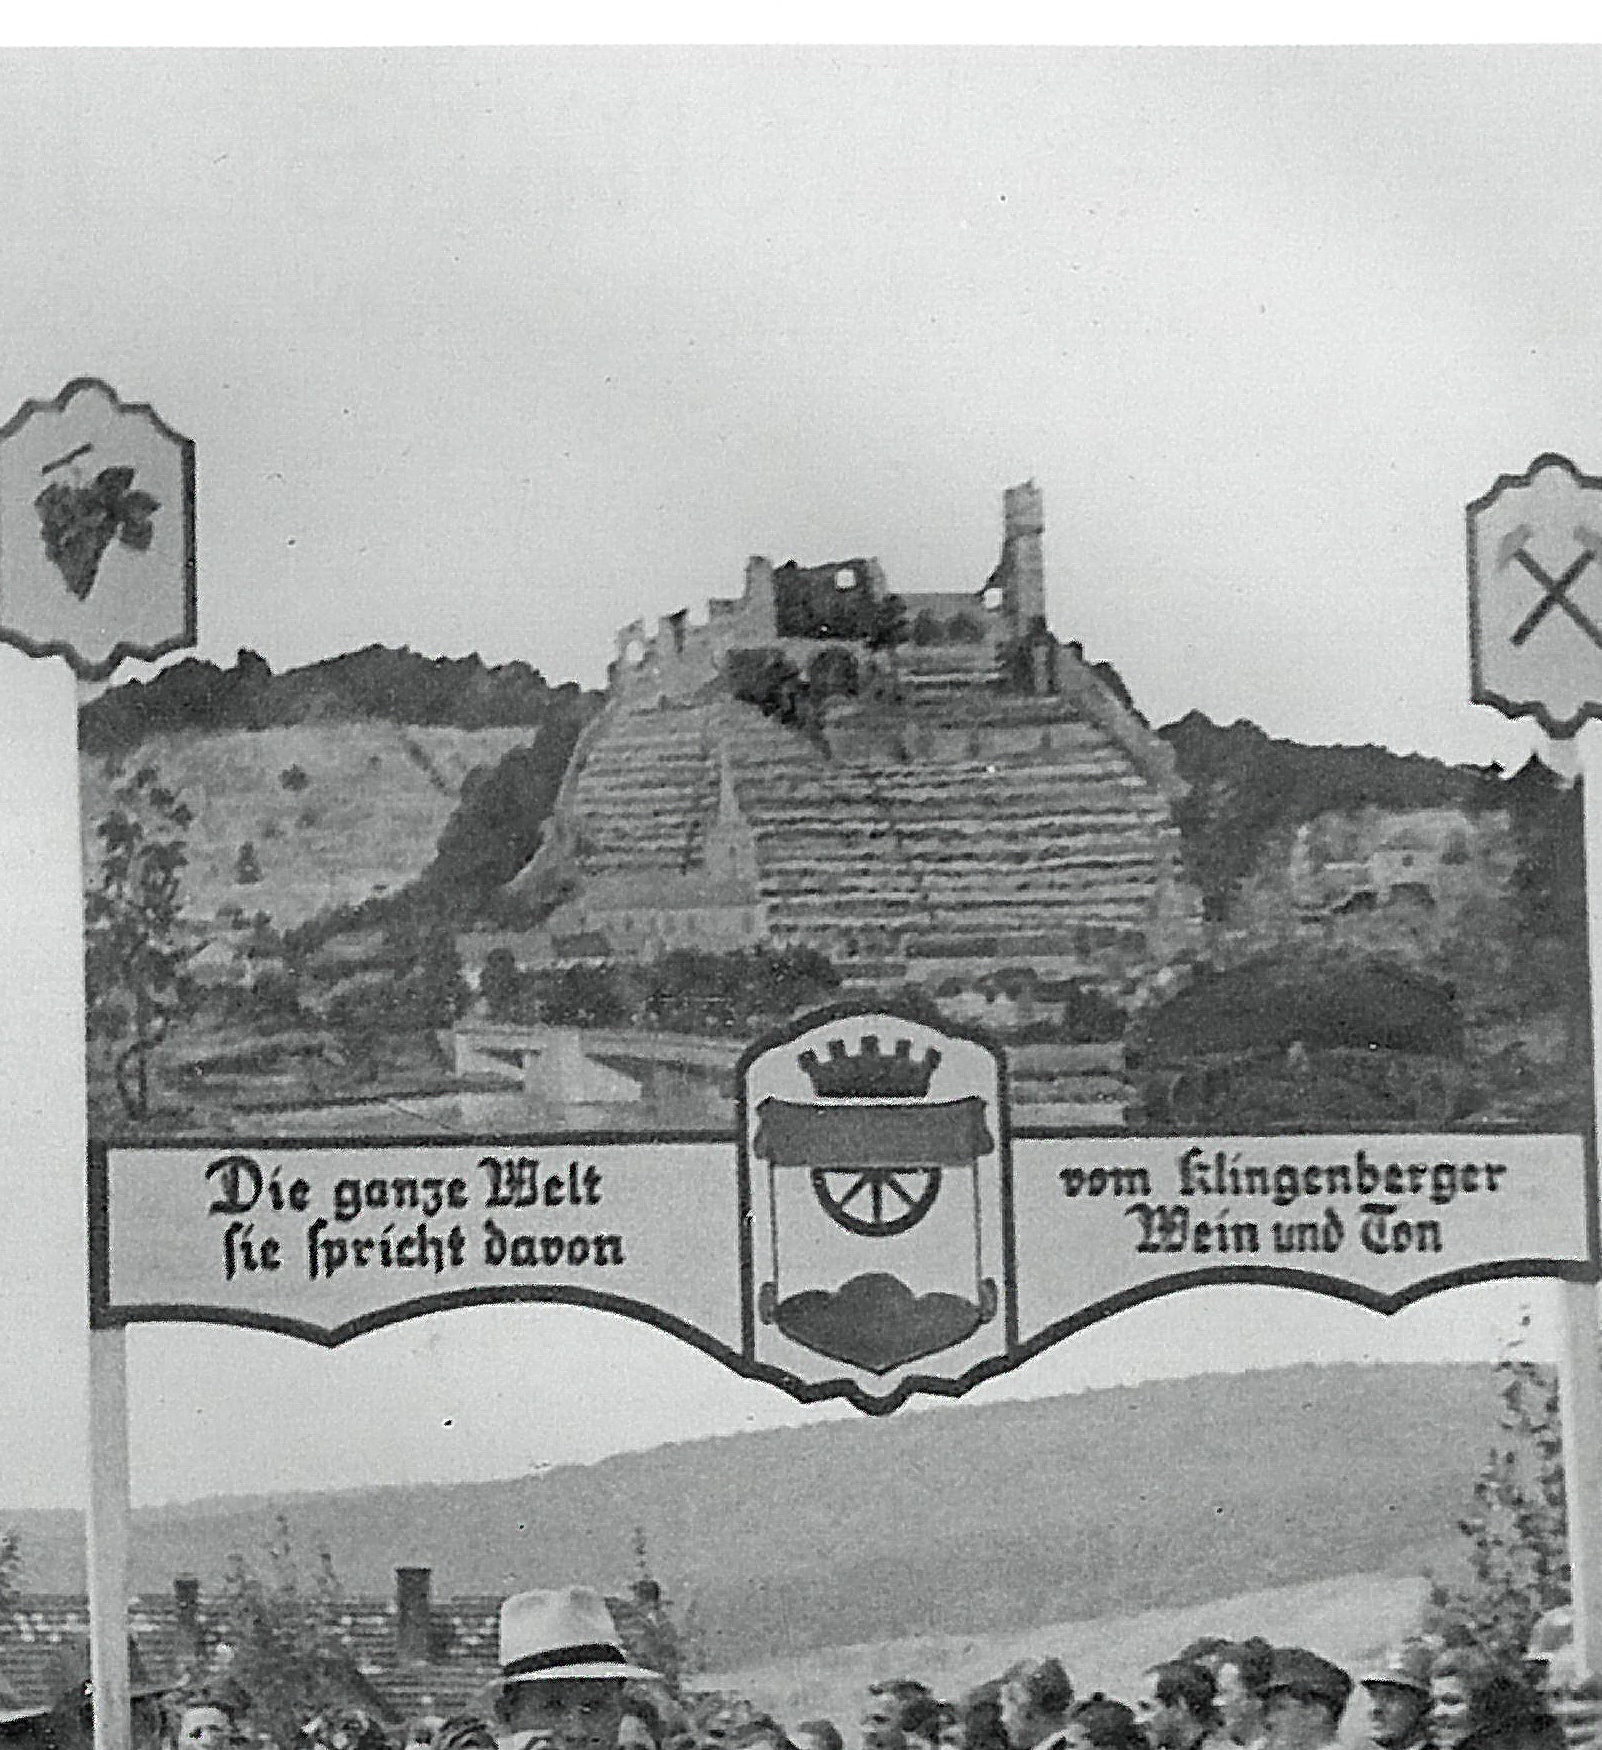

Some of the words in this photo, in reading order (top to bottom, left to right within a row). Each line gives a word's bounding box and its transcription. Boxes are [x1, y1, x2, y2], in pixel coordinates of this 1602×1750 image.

[204, 1155, 311, 1216] Die
[333, 1170, 468, 1221] ganze
[477, 1155, 603, 1209] Welt
[1177, 1146, 1508, 1206] Klingenberger
[483, 1217, 626, 1268] davon
[1123, 1202, 1261, 1254] Wein
[1272, 1206, 1344, 1254] und
[1359, 1202, 1443, 1255] Ton
